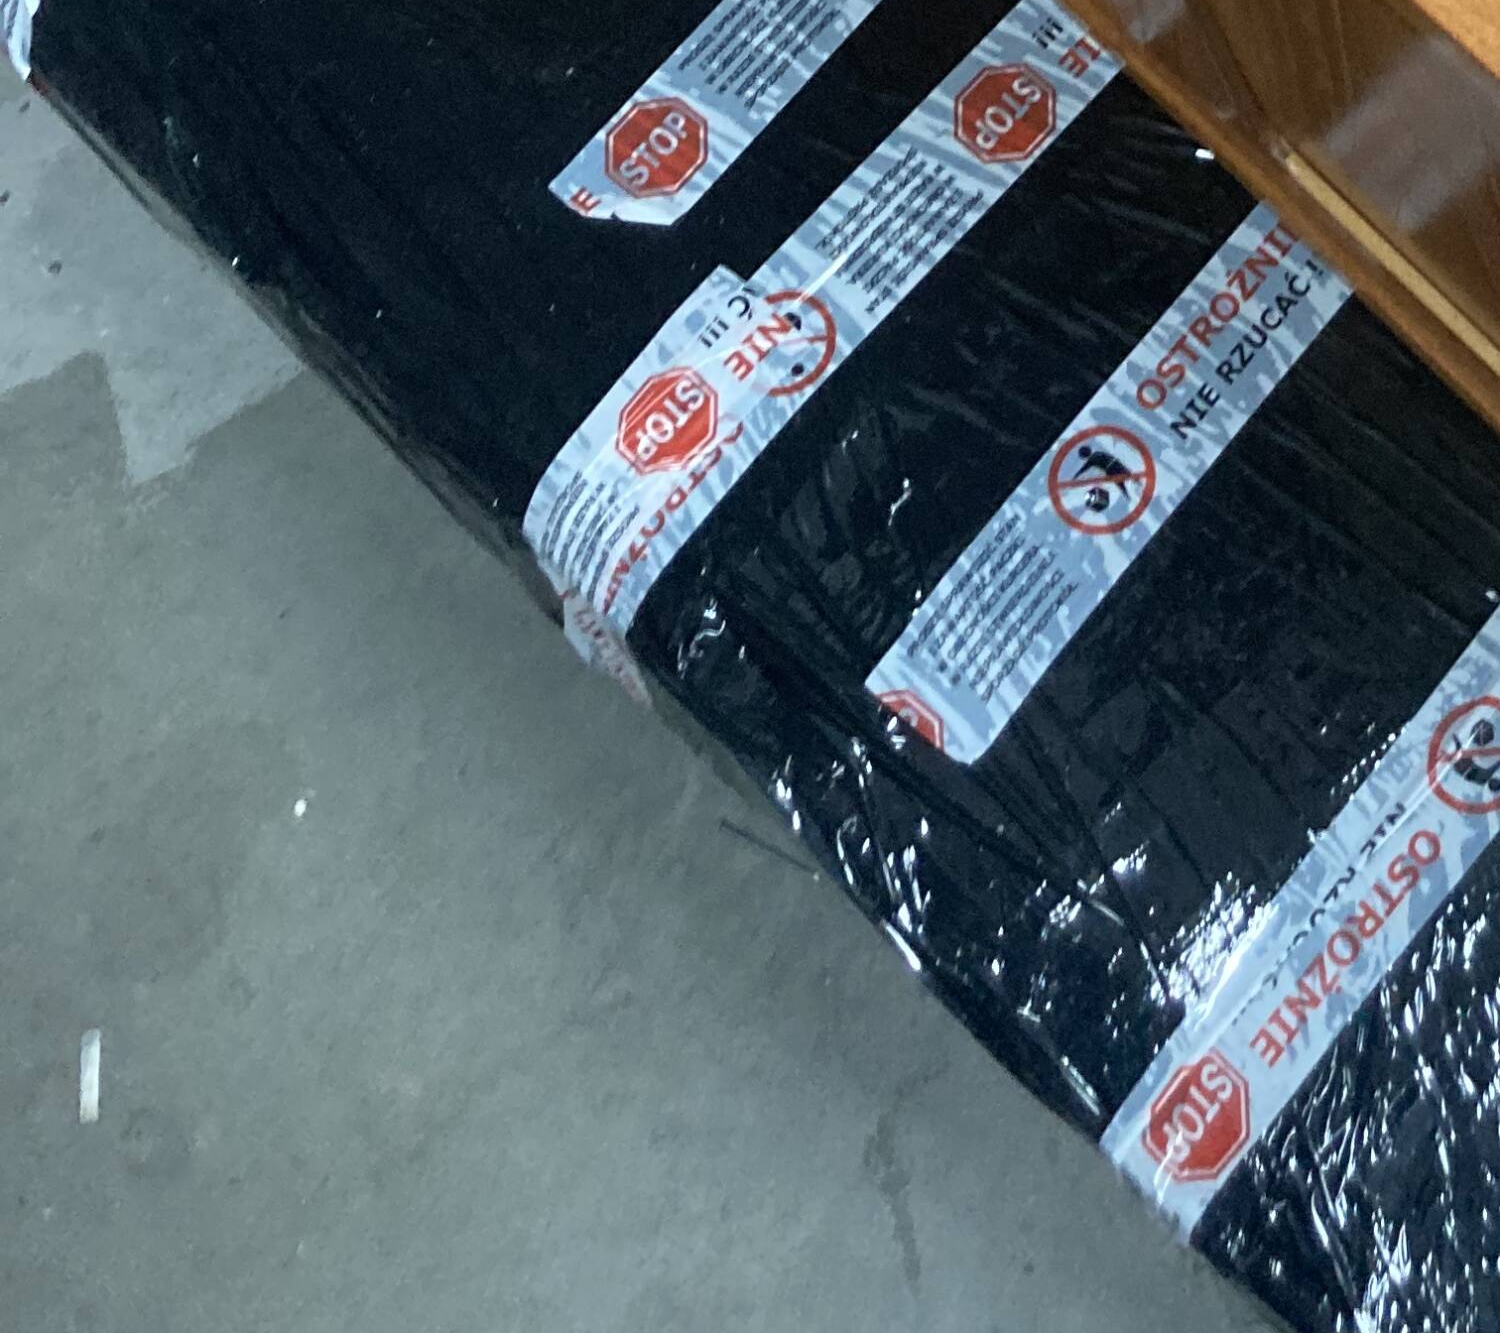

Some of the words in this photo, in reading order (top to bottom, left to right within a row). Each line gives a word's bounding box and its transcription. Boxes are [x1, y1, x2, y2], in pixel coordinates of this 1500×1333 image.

[619, 110, 690, 193] STOP
[974, 76, 1043, 152] STOP
[725, 313, 794, 381] NIE
[1170, 383, 1221, 440] NIE
[1219, 273, 1316, 383] RZUCAĆ
[635, 378, 705, 459] STOP
[1250, 829, 1442, 1068] OSTROŻNIE
[1168, 1059, 1233, 1159] STOP
